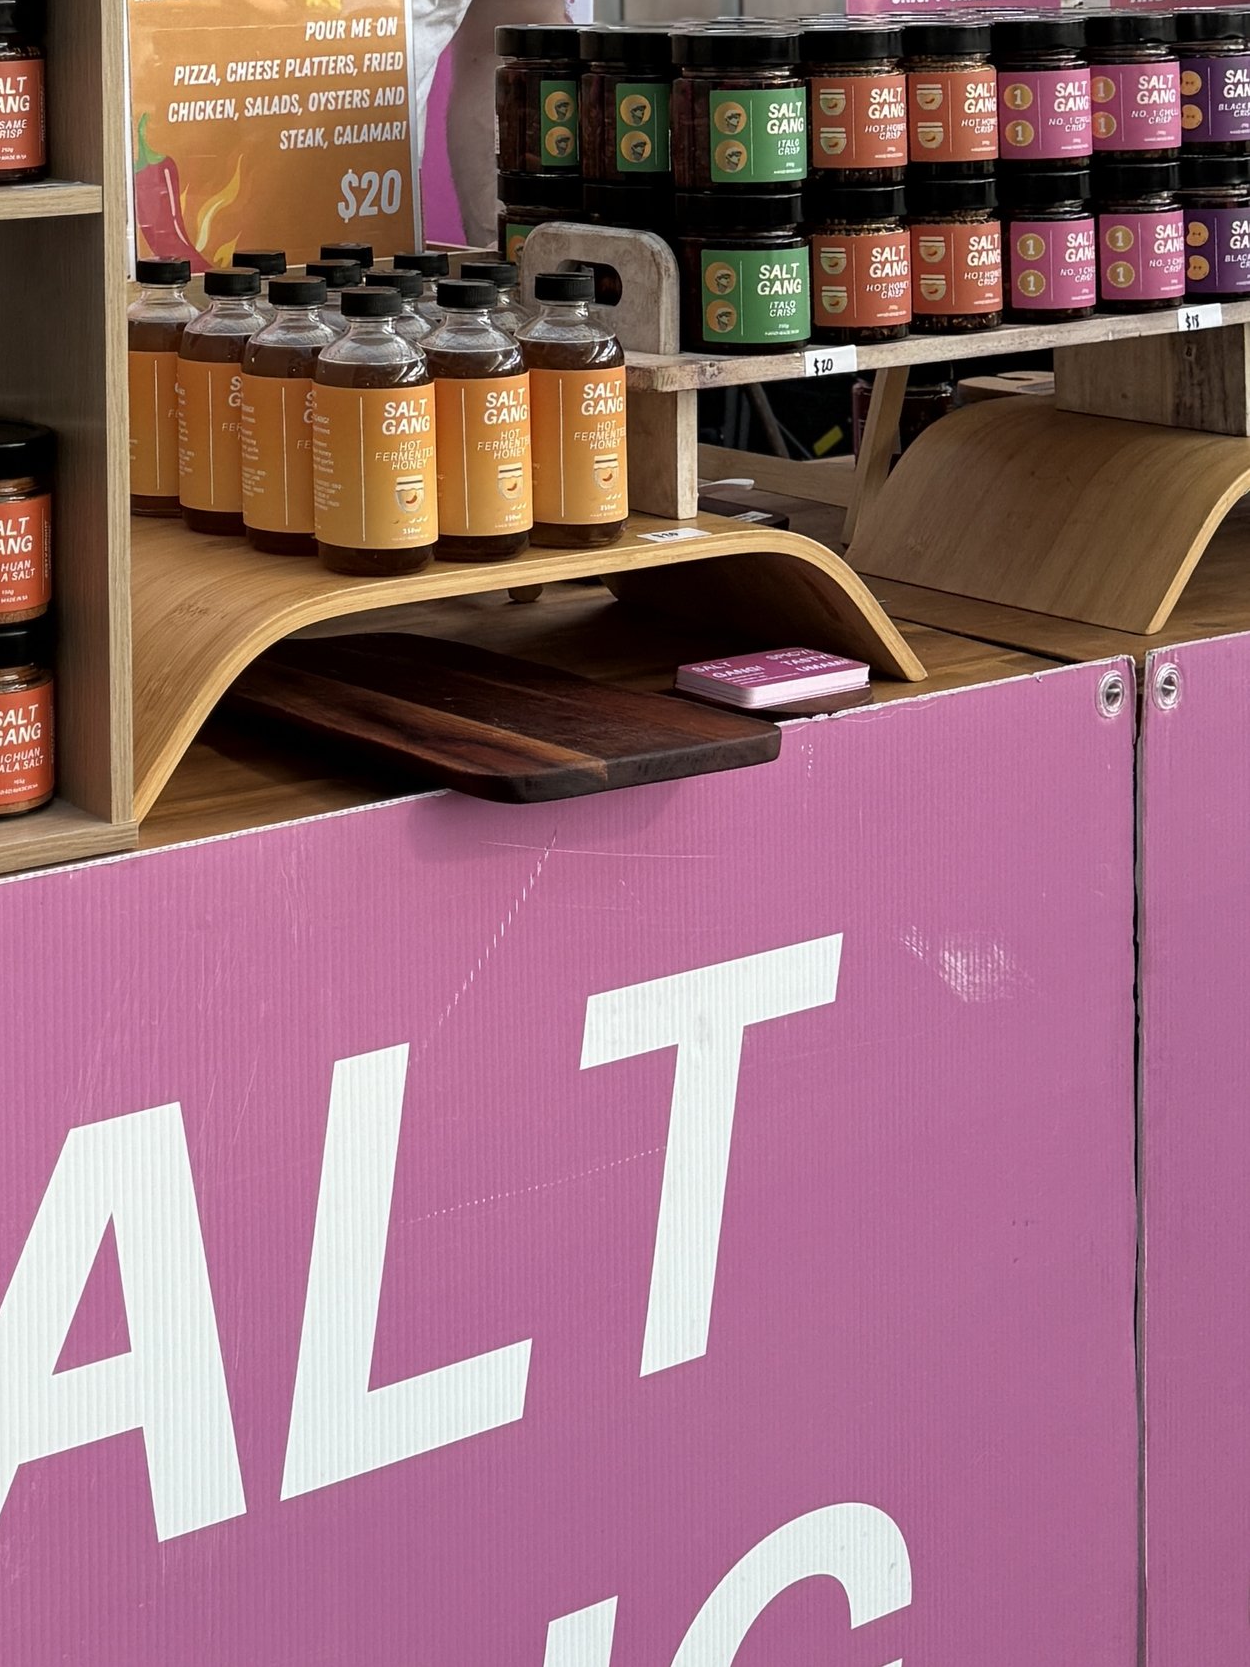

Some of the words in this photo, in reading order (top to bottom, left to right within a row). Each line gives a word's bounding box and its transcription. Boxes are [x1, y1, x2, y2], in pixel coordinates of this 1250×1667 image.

[305, 20, 345, 41] POUR
[350, 19, 373, 39] ME
[376, 17, 397, 37] ON
[174, 63, 221, 86] PIZZA,
[226, 59, 280, 83] CHEESE
[284, 54, 359, 79] PLATTERS,
[363, 51, 404, 73] FRIED
[168, 97, 239, 123] CHICKEN,
[244, 94, 303, 117] SALADS,
[308, 89, 370, 112] OYSTERS
[374, 86, 405, 106] AND
[768, 102, 802, 118] SALT
[279, 127, 328, 150] STEAK,
[333, 121, 407, 145] CALAMARI
[767, 117, 804, 135] GANG
[337, 168, 402, 224] $20
[871, 245, 906, 262] SALT
[870, 261, 908, 277] GANG
[384, 398, 427, 418] SALT
[382, 416, 430, 435] GANG
[400, 440, 421, 450] HOT
[392, 458, 427, 470] HONEY
